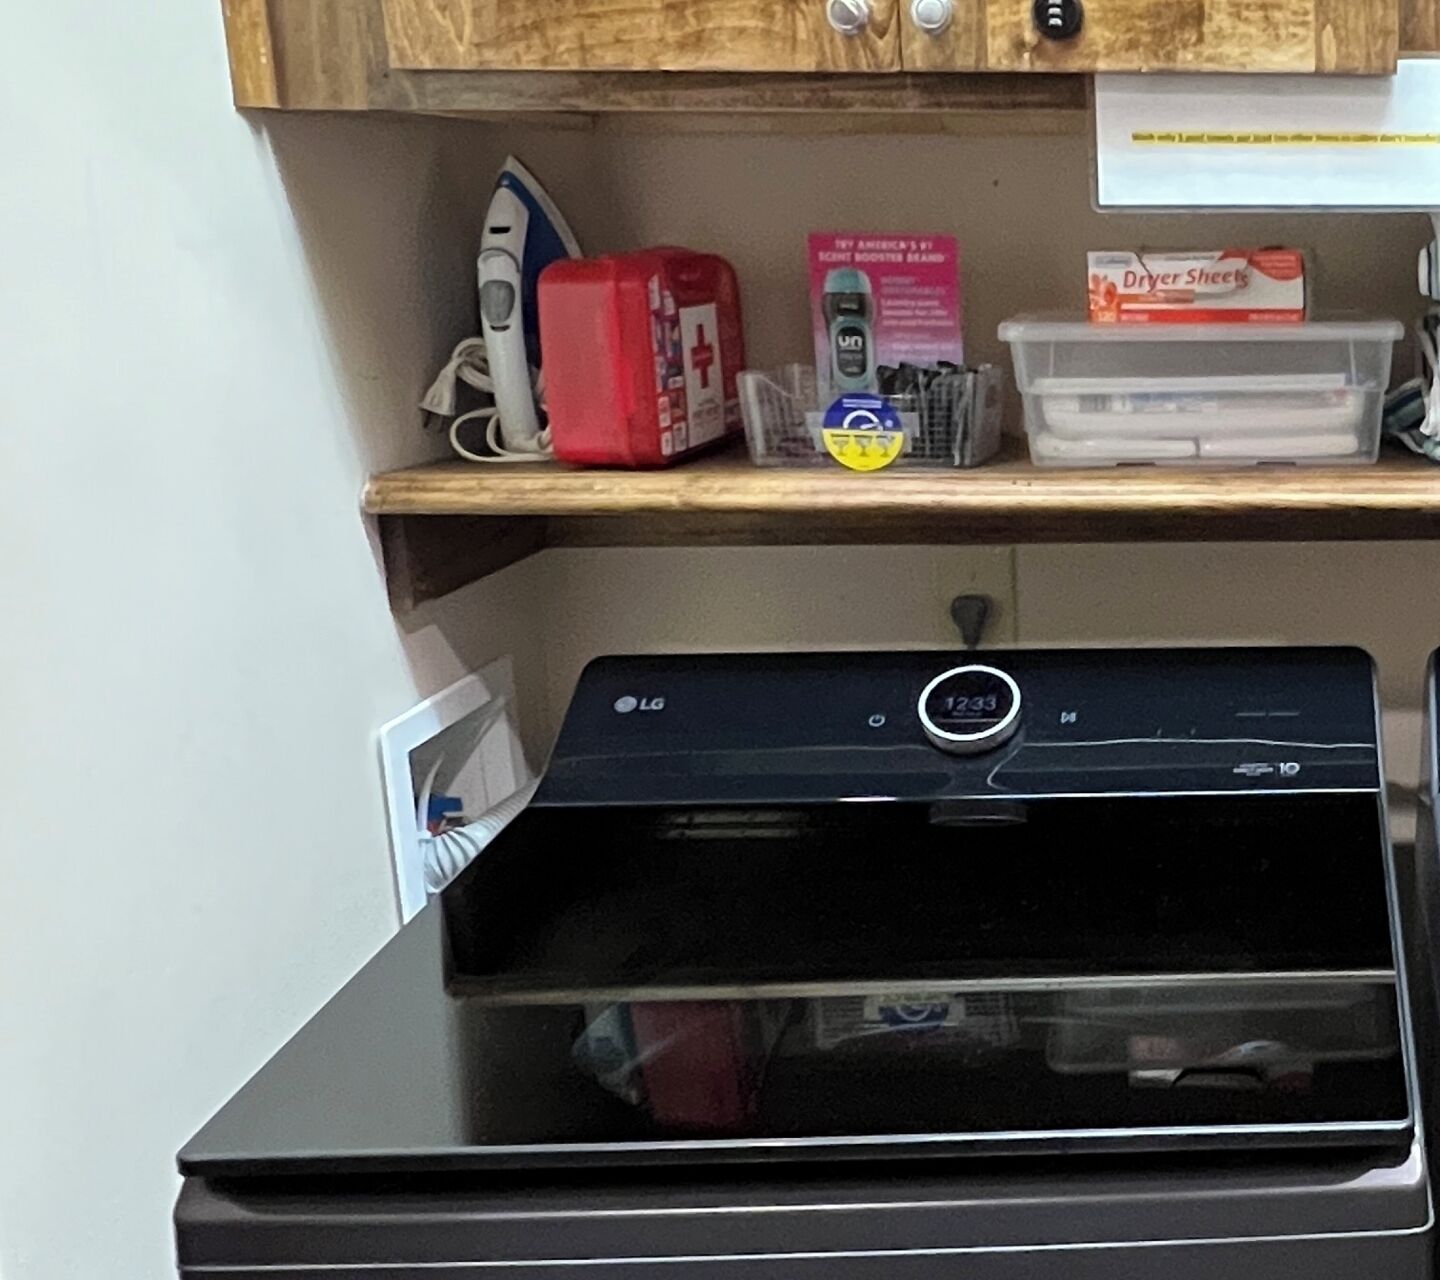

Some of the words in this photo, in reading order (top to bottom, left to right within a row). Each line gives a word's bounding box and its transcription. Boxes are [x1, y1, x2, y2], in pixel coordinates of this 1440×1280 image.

[835, 240, 854, 250] TRY
[818, 251, 852, 262] SCENT
[854, 252, 903, 263] BOOSTER
[1123, 270, 1180, 293] Dryer
[1185, 267, 1249, 289] Sheets
[639, 697, 666, 710] LG
